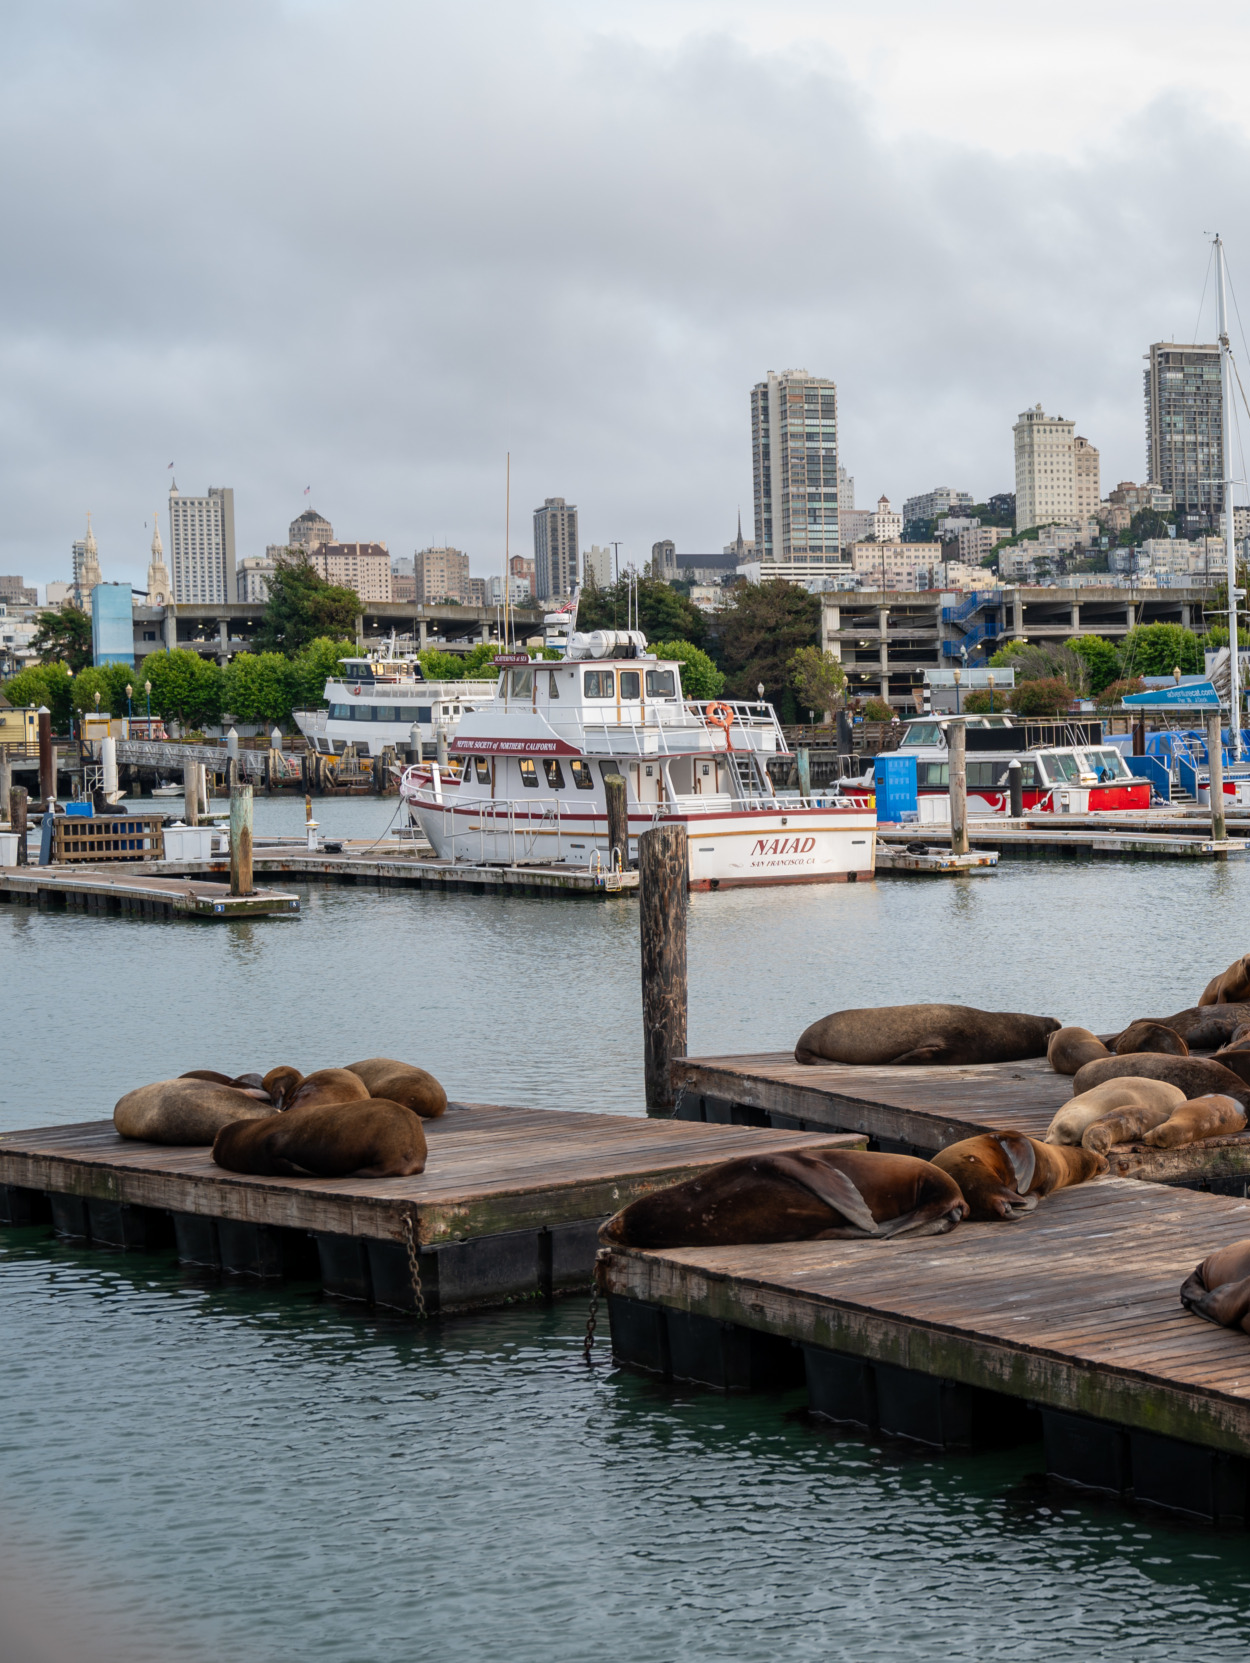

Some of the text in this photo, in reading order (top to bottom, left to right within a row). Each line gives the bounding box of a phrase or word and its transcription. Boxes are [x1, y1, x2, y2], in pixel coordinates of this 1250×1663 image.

[1166, 688, 1214, 698] adventurecat.com
[456, 740, 557, 751] NEPTUNE SOCIETY of NORTHERN CALIFORNIA
[750, 837, 816, 856] NAIAD
